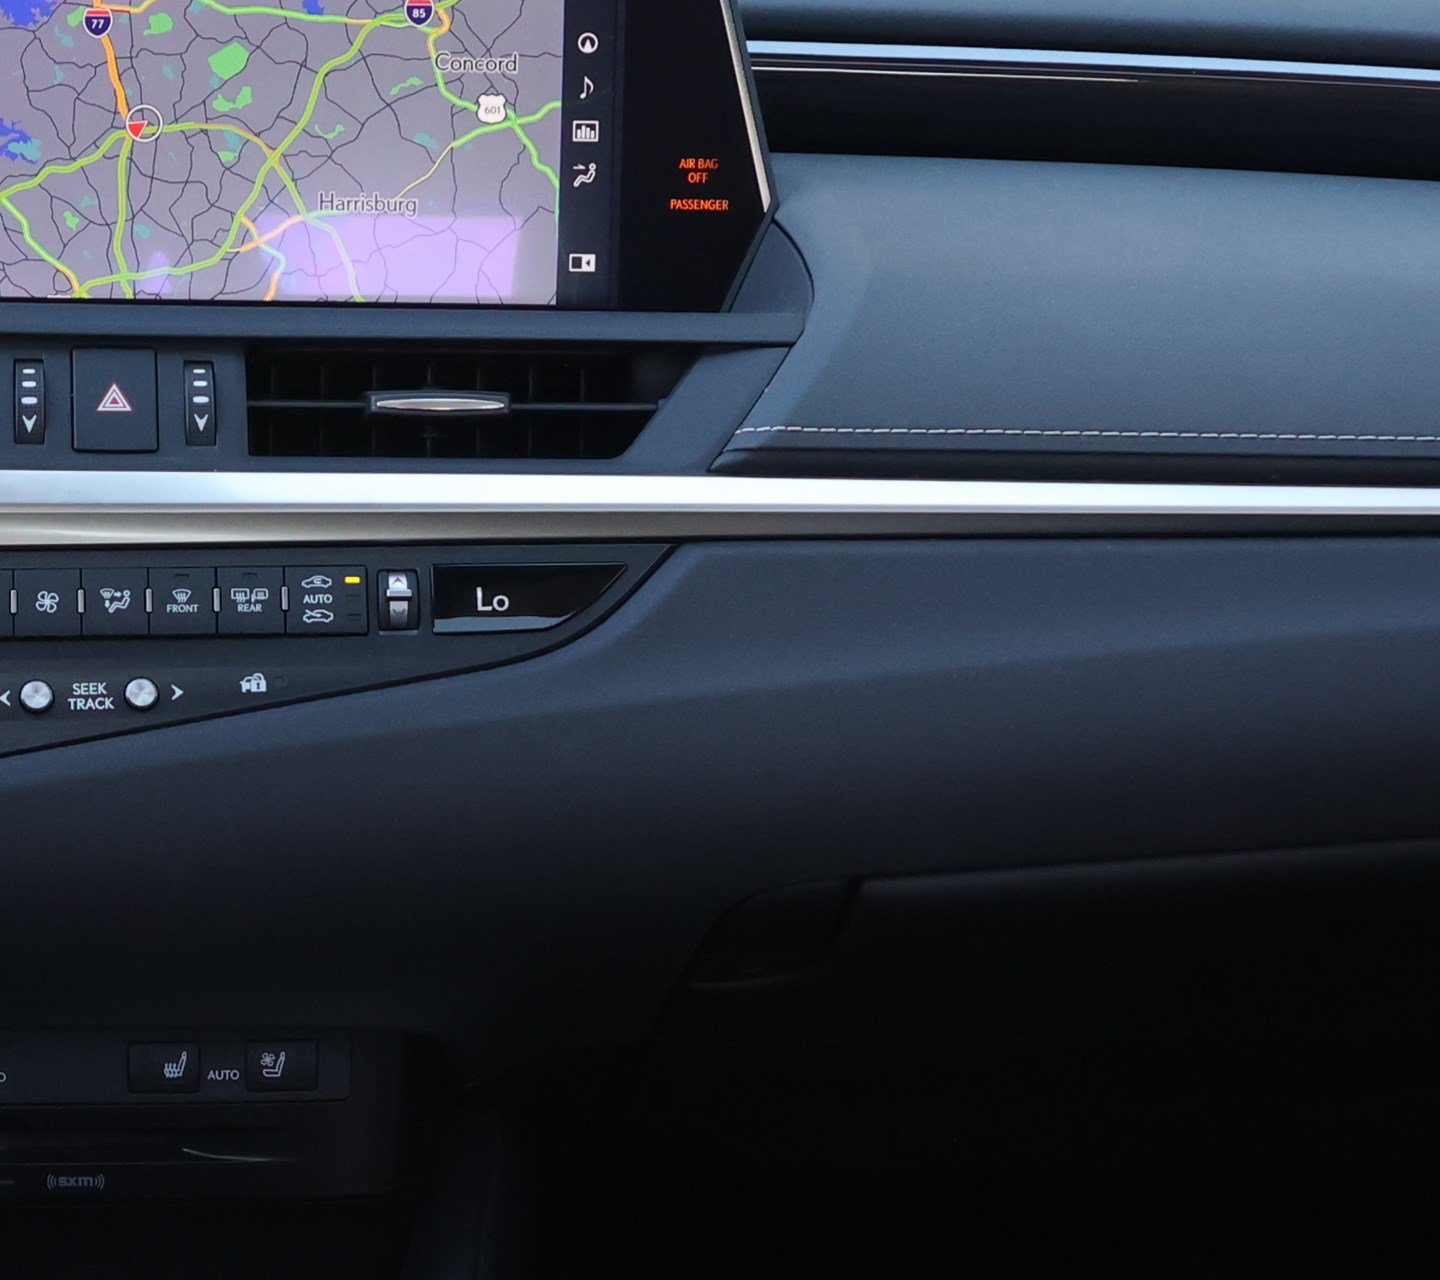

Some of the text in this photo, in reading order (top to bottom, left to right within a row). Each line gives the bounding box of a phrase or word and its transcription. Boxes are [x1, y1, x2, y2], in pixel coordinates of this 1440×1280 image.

[412, 8, 426, 18] 85
[91, 19, 105, 29] 77
[435, 51, 518, 72] Concord
[484, 106, 501, 114] 601
[679, 158, 719, 170] AIR BAG
[687, 172, 709, 183] OFF
[318, 192, 417, 219] Harrisburg
[670, 198, 730, 211] PASSENGER
[302, 594, 333, 605] AUTO
[476, 586, 510, 612] Lo
[166, 602, 199, 614] FRONT
[237, 602, 263, 613] REAR
[72, 683, 108, 695] SEEK
[67, 696, 115, 711] TRACK
[207, 1069, 240, 1081] AUTO
